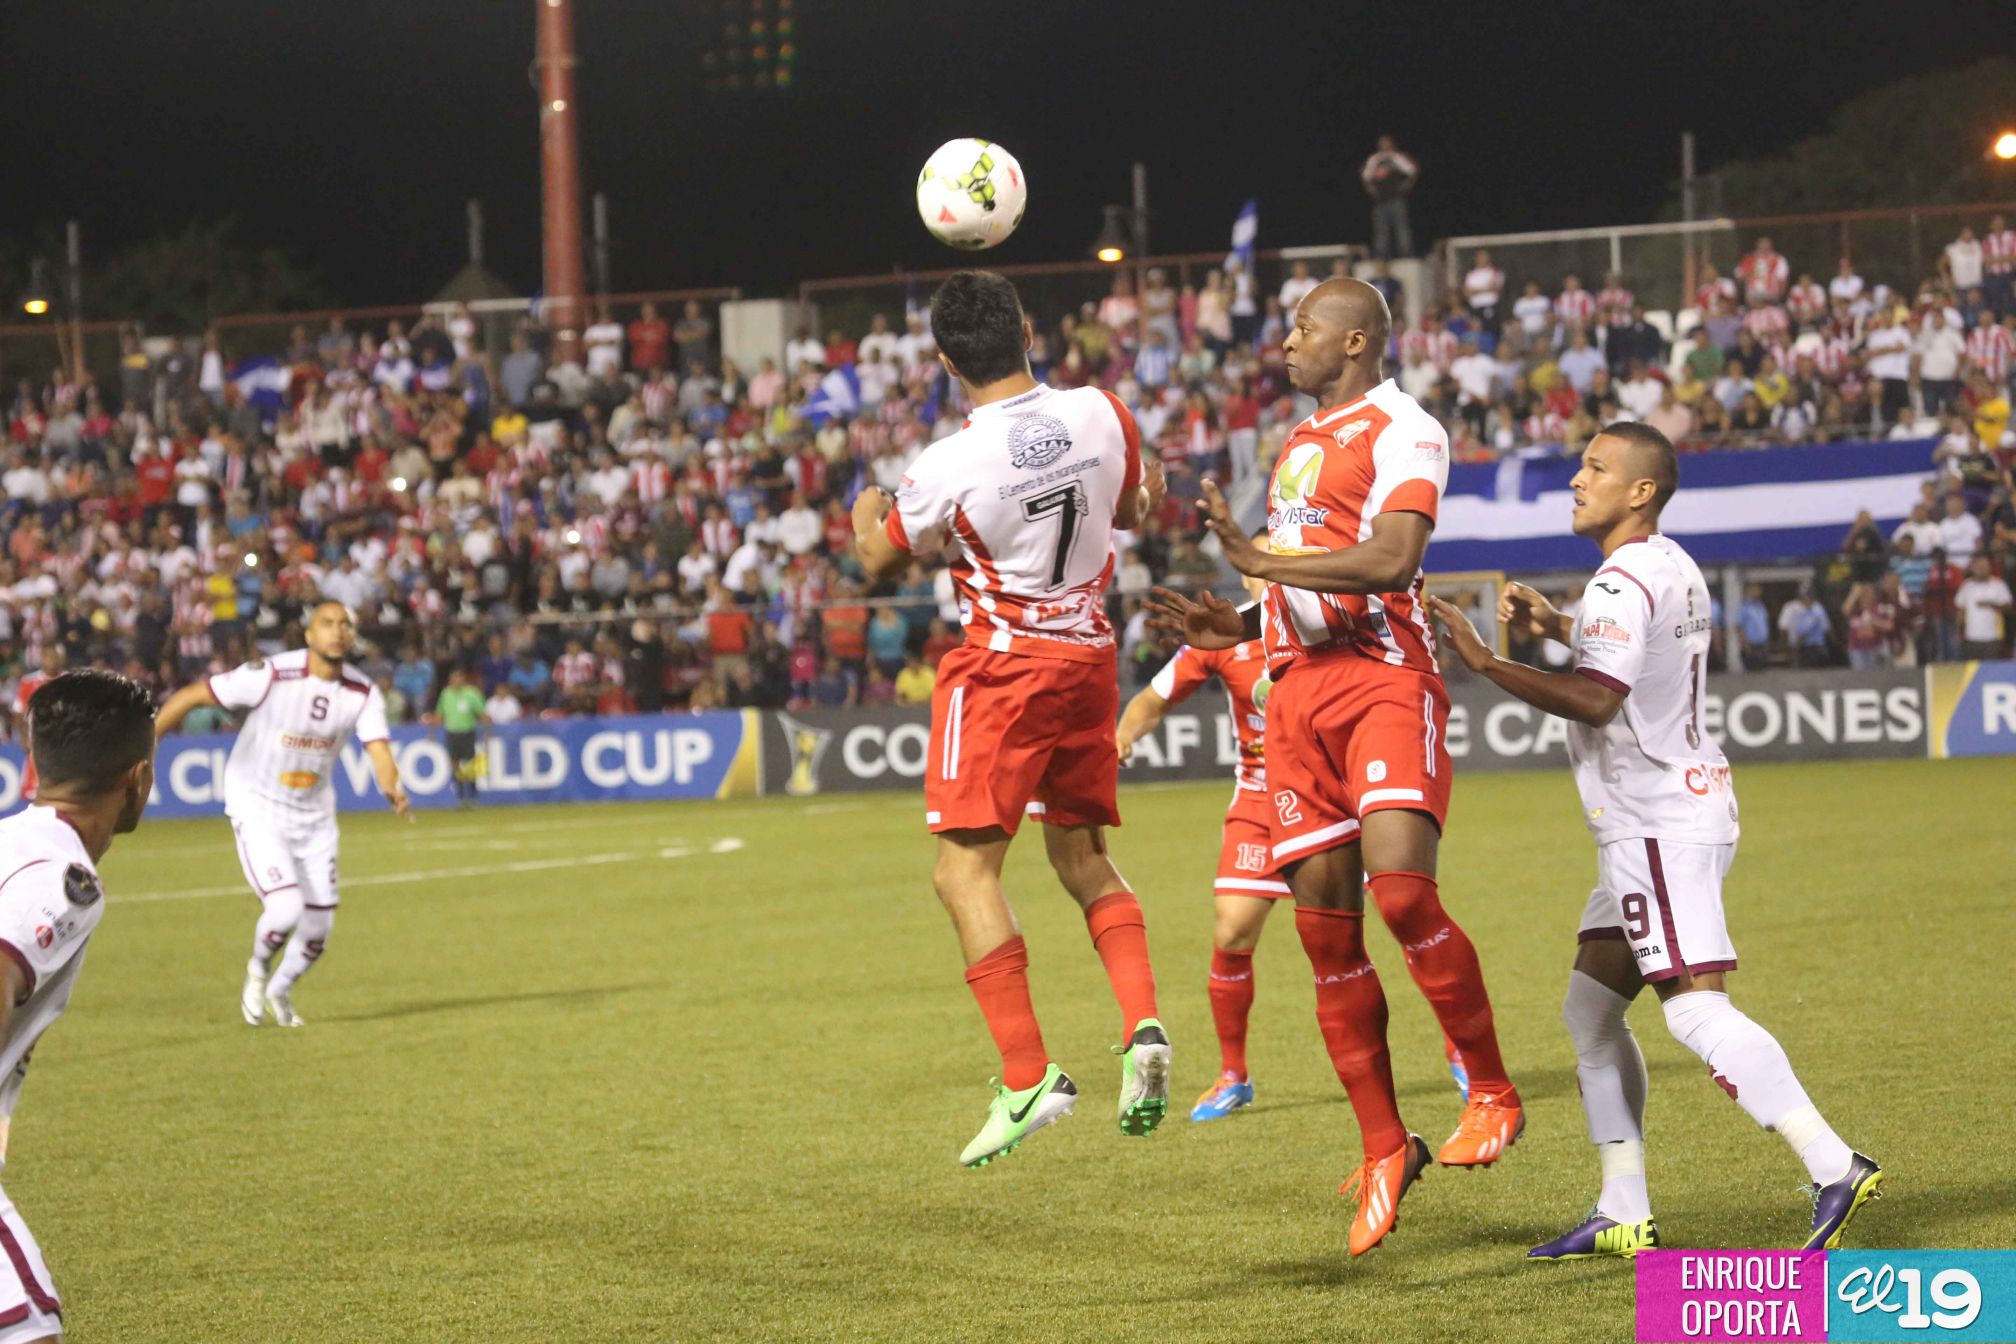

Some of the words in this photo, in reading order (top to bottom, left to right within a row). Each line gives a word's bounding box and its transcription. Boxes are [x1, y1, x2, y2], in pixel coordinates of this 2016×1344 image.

[1014, 440, 1070, 468] CANAL
[1020, 479, 1084, 593] 7
[1583, 622, 1601, 637] PAPA
[310, 695, 330, 721] S
[1484, 686, 1923, 757] CAEONES
[340, 734, 570, 797] WOLD
[581, 728, 713, 788] CUP
[1274, 788, 1303, 827] 2
[1234, 842, 1267, 873] 15
[1621, 892, 1651, 942] 9
[1633, 945, 1661, 960] oma
[1594, 1214, 1655, 1251] NIKE
